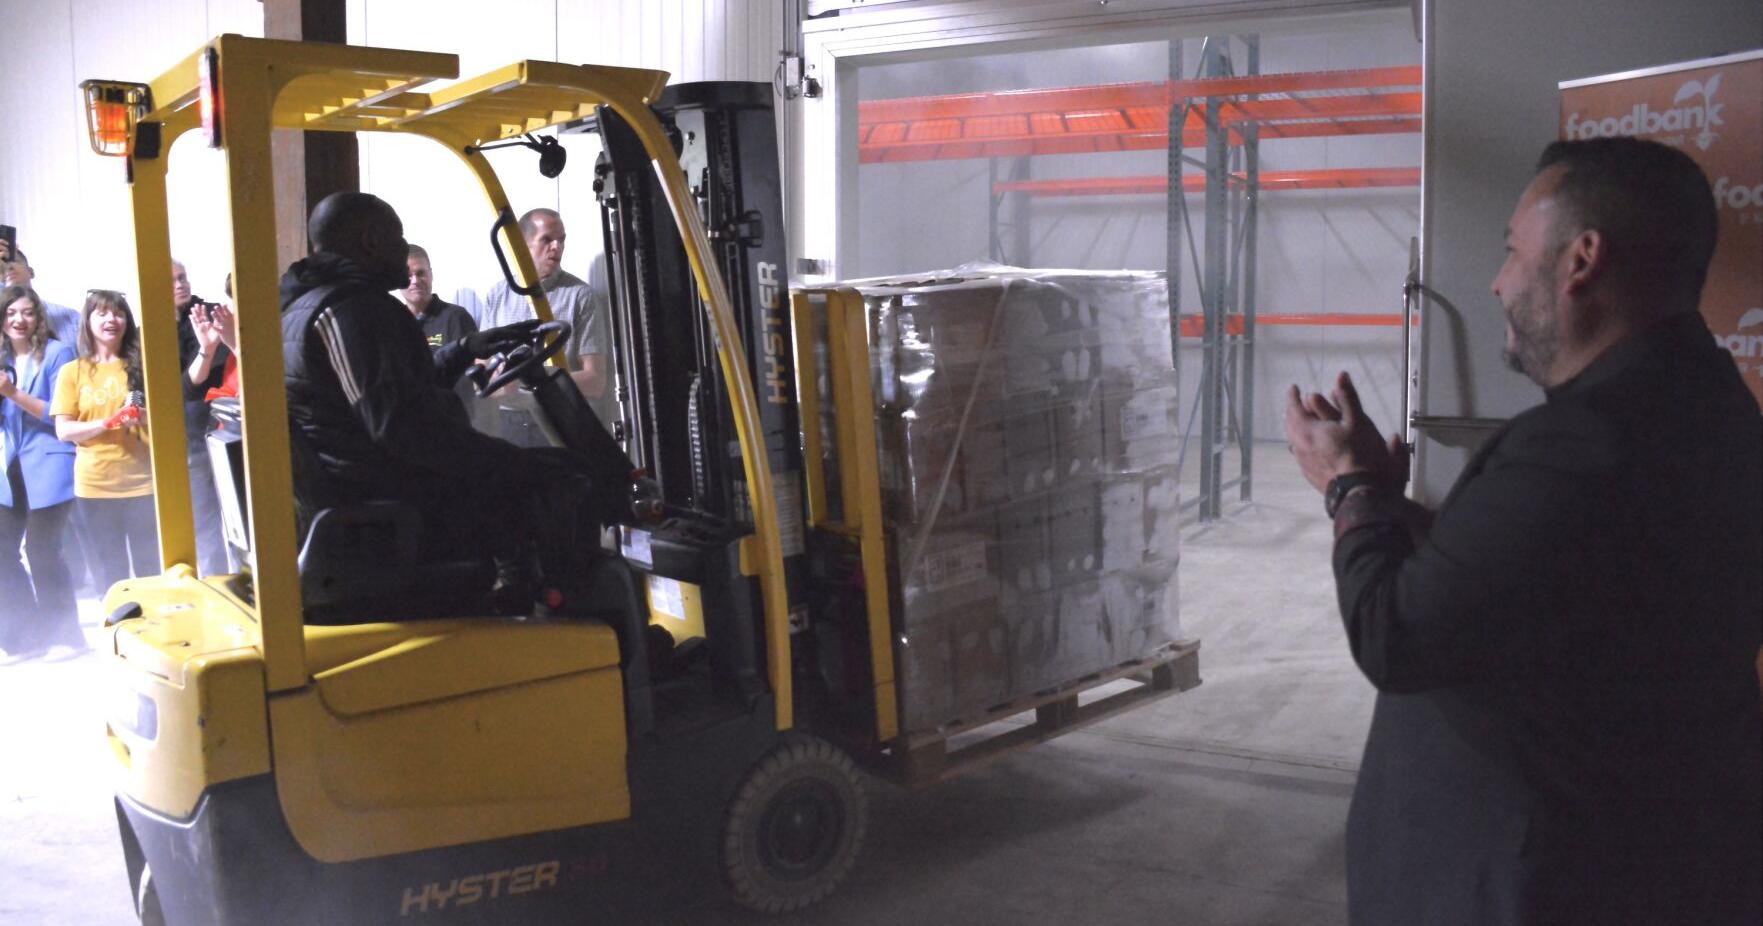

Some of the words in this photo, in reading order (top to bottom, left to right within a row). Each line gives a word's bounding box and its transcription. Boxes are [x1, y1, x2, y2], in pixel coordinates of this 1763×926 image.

[1565, 103, 1725, 141] foodbank
[757, 261, 788, 405] HYSTER
[400, 860, 560, 917] HYSTER
